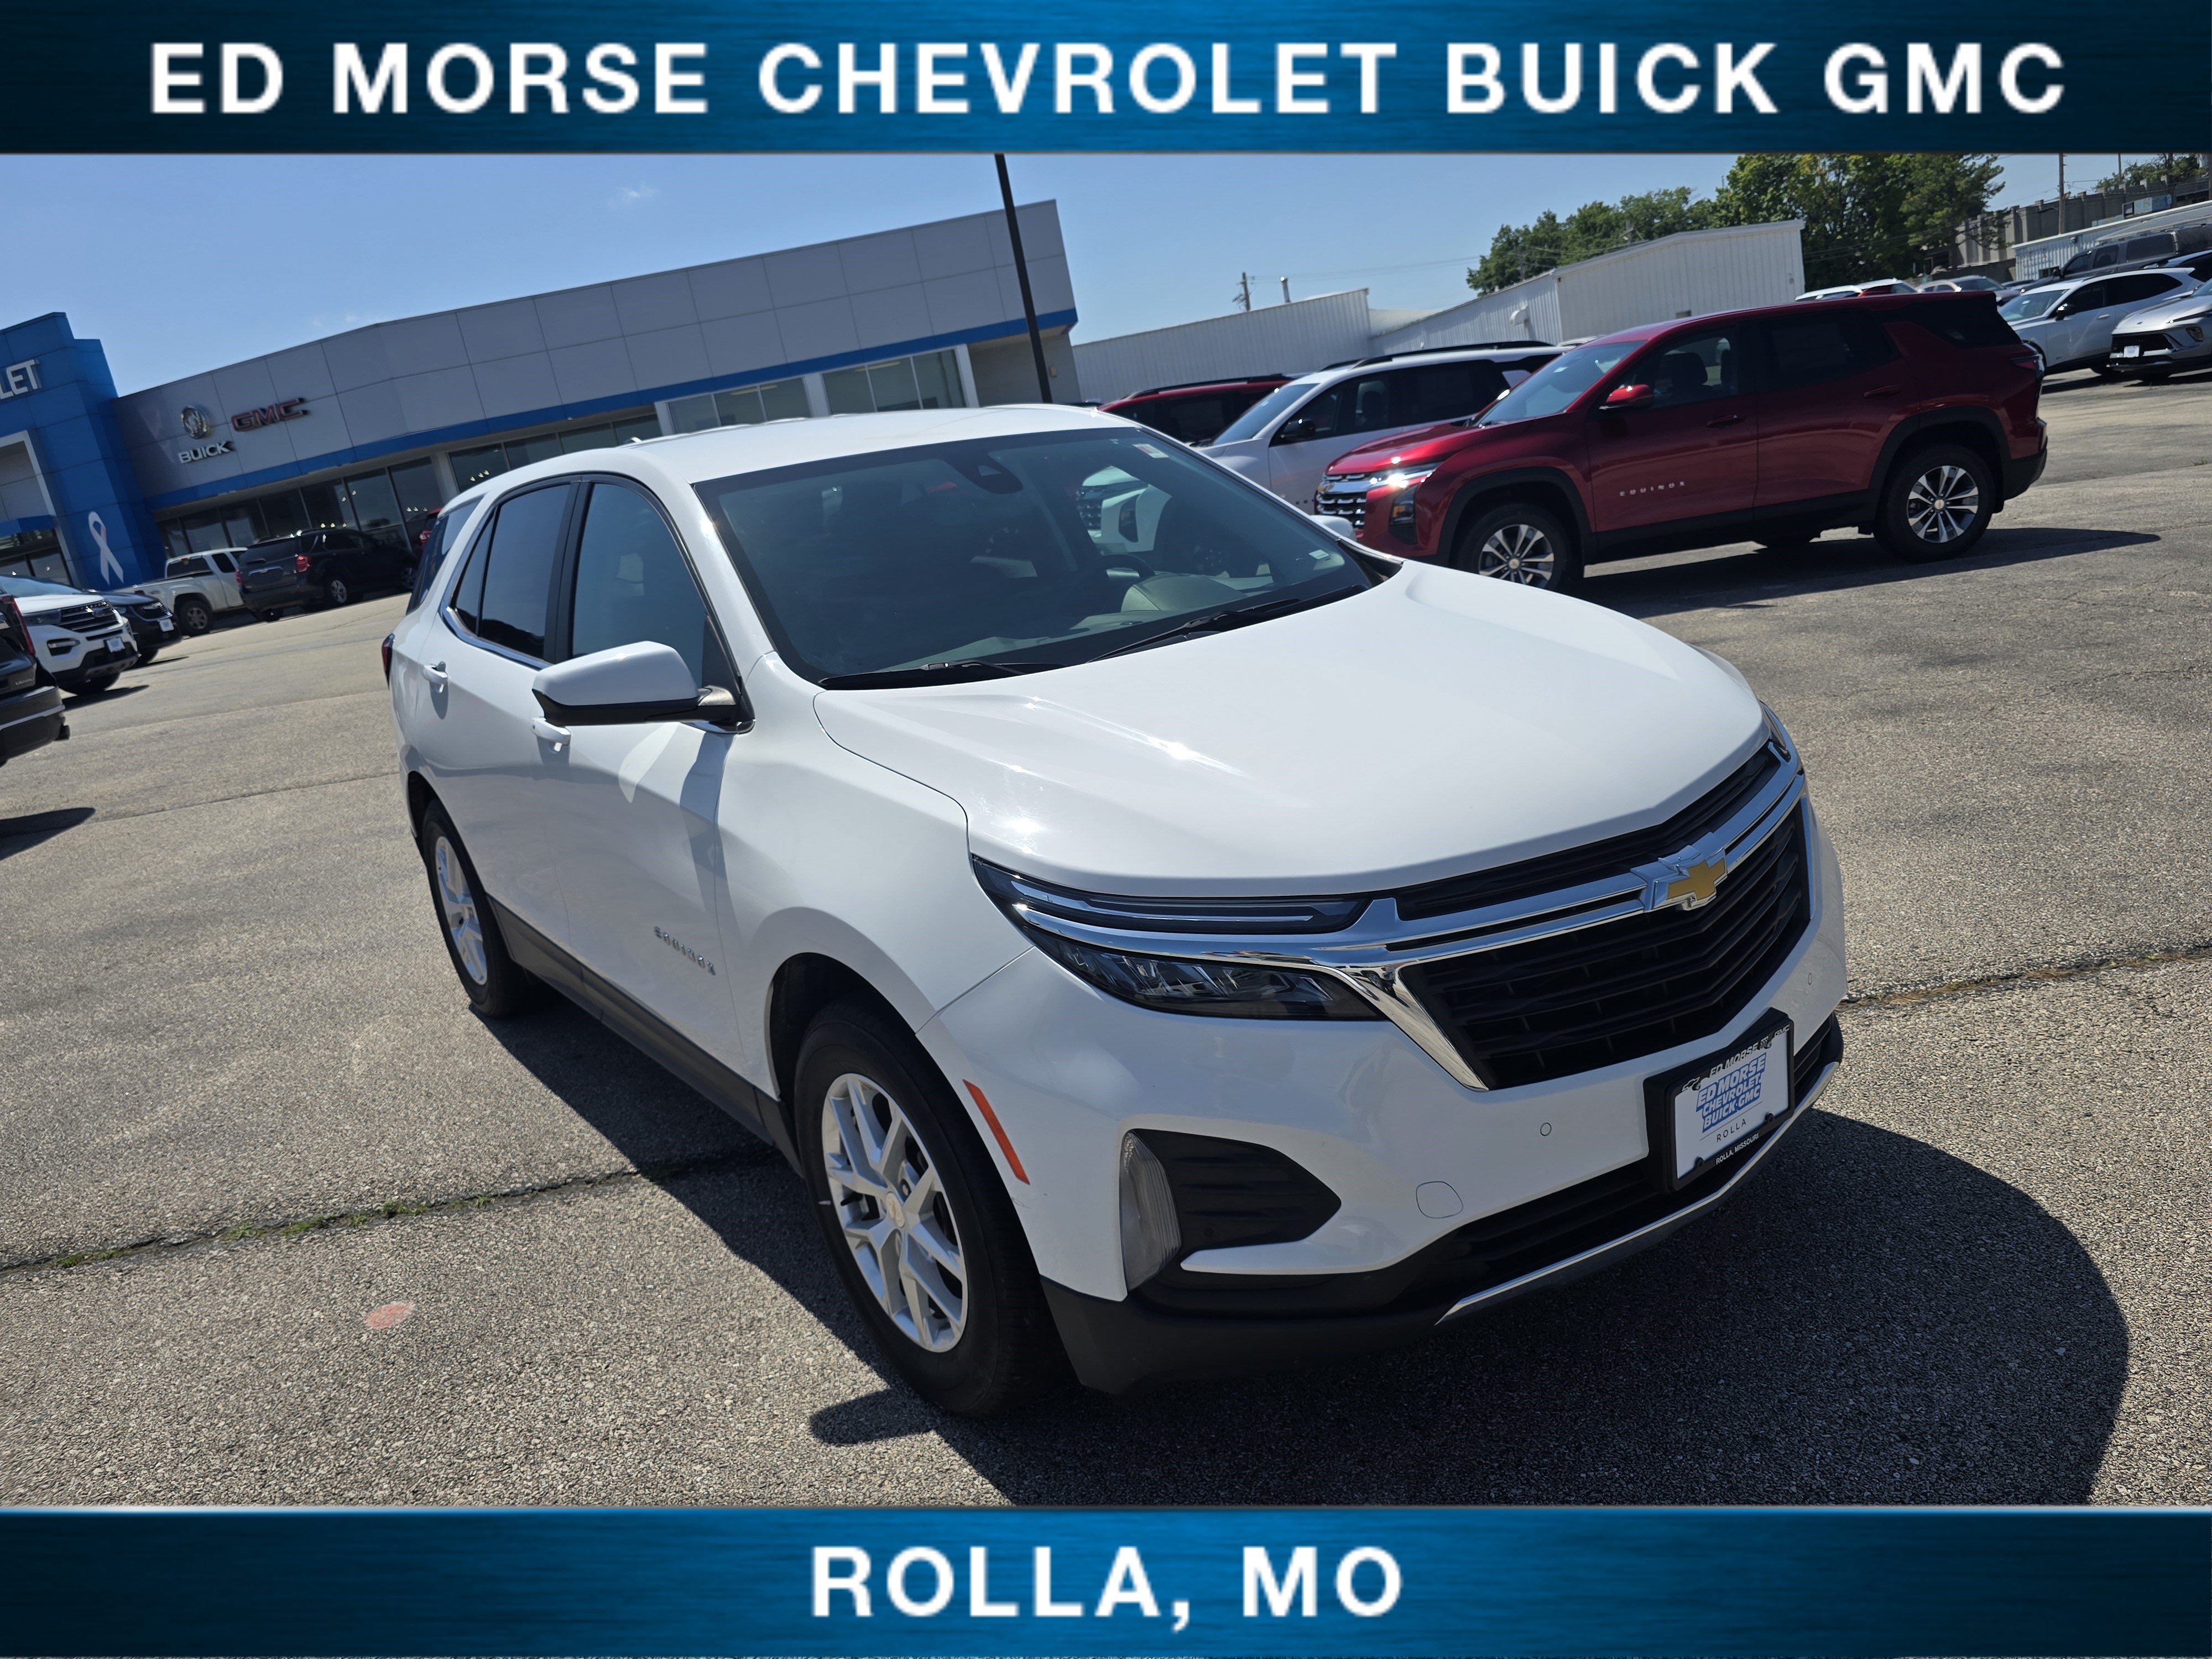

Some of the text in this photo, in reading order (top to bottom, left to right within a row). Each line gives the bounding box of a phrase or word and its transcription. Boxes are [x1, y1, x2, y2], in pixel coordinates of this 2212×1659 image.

[231, 399, 303, 432] GMC
[178, 442, 230, 463] BUICK
[1774, 1024, 1790, 1038] GMC
[1710, 1042, 1759, 1077] ED MORSE
[1697, 1053, 1766, 1107] ED MORSE
[1703, 1073, 1761, 1117] CHEVROLET
[1717, 1119, 1746, 1142] ROLLA
[1716, 1133, 1759, 1165] ROLLA, MISSOURI
